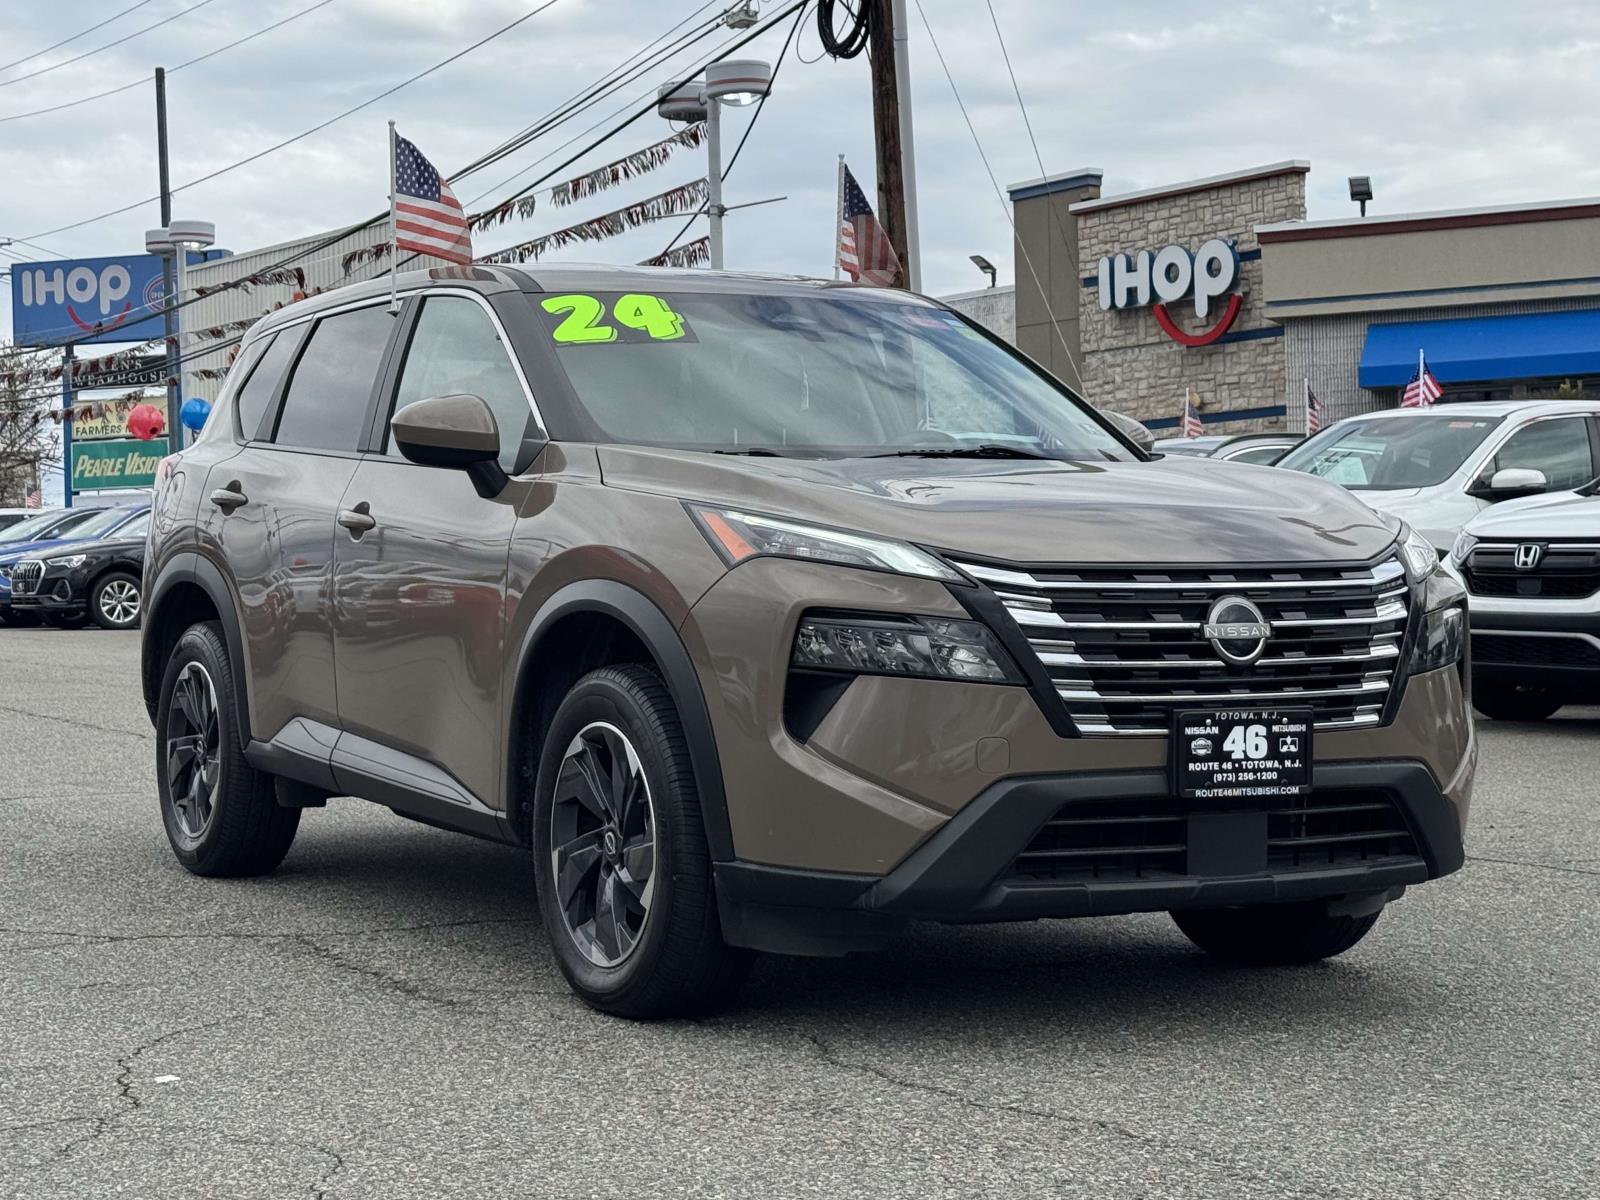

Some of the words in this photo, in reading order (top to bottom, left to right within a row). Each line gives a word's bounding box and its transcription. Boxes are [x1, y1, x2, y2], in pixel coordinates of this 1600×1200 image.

[1098, 239, 1235, 318] IHOP
[21, 264, 131, 315] IHOP
[540, 293, 685, 343] 24
[75, 424, 122, 436] FARMERS
[74, 454, 125, 478] PEARLE
[1206, 626, 1270, 637] NISSAN
[1184, 726, 1219, 735] NISSAN
[1272, 724, 1307, 733] MITSUBISHI
[1222, 724, 1268, 760] 46
[1188, 762, 1220, 771] ROUTE
[1221, 761, 1233, 770] 46
[1241, 760, 1282, 769] TOTOWA,
[1284, 759, 1302, 768] N.J.
[1213, 772, 1236, 783] (973)
[1238, 771, 1278, 780] 256-1200
[1195, 786, 1300, 797] ROUTE46MITSUBISHI.COM
